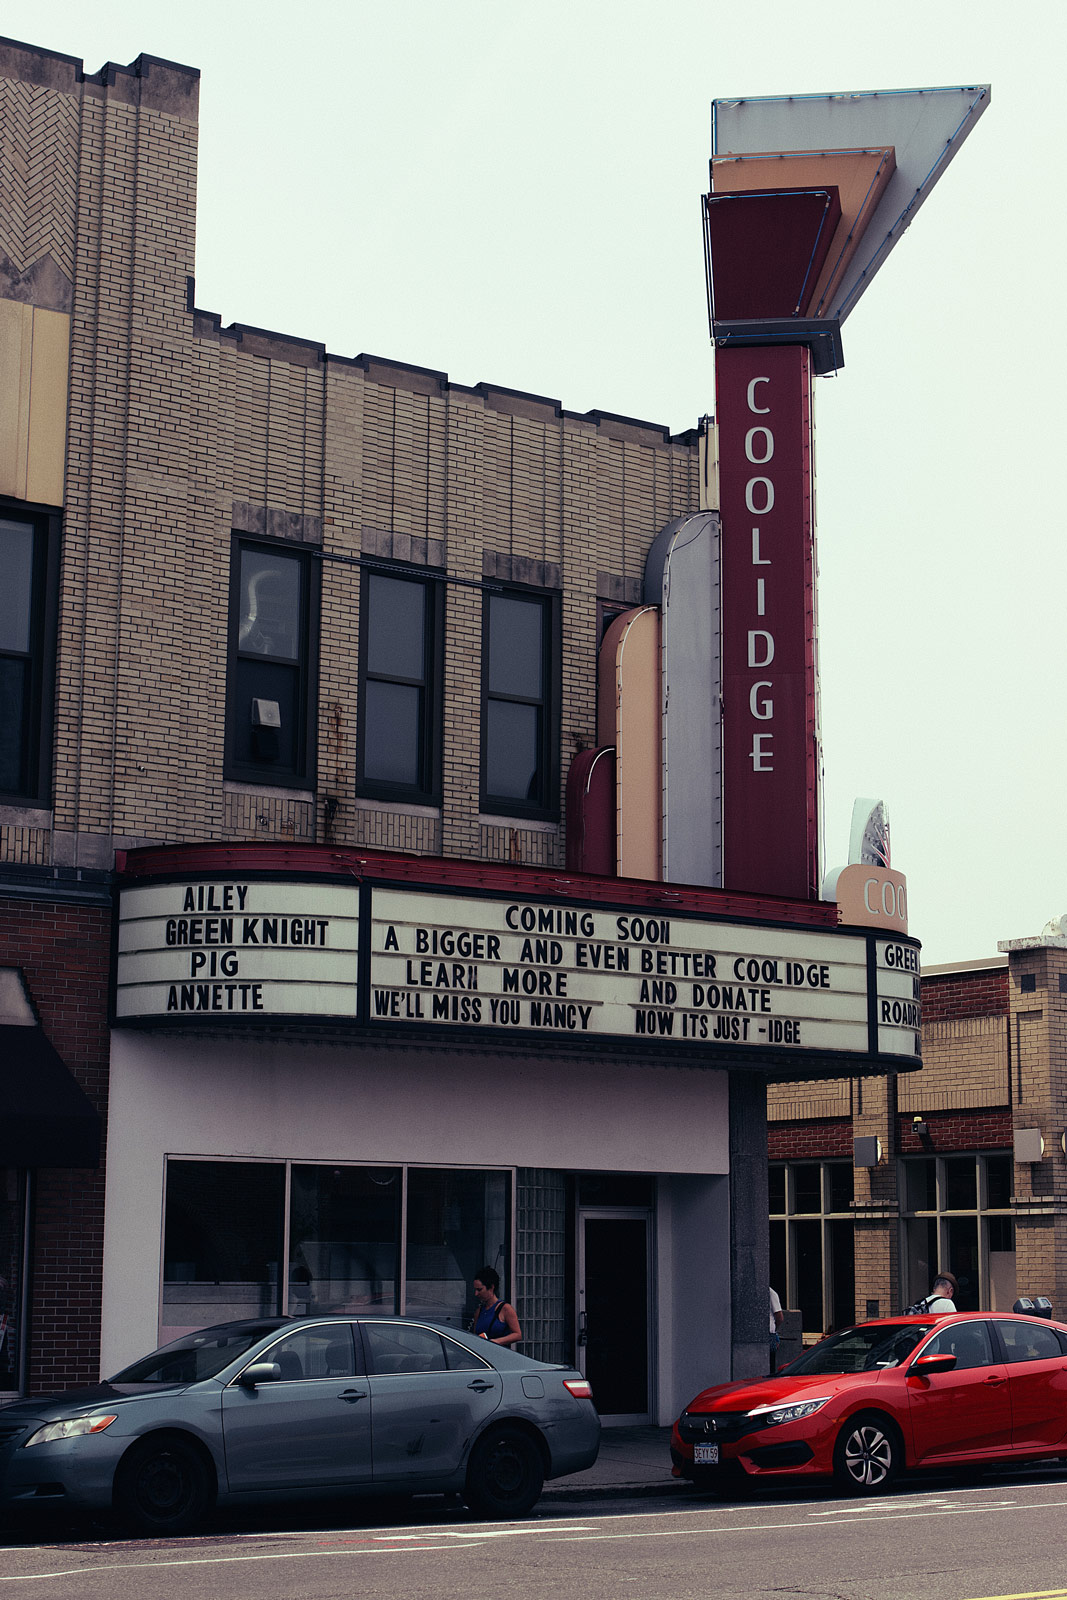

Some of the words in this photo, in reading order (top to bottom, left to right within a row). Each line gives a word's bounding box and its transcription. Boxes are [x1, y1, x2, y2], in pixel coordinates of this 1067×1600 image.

[744, 376, 776, 772] COOLIDGE
[184, 886, 248, 912] AILEY
[864, 878, 907, 920] COO
[166, 919, 233, 945] GREEN
[242, 919, 328, 945] KNIGHT
[506, 905, 594, 937] COMING
[616, 917, 670, 944] SOON
[191, 951, 239, 977] PIG
[384, 926, 399, 951] A
[416, 928, 501, 960] BIGGER
[520, 938, 563, 965] AND
[576, 942, 629, 971] EVEN
[641, 949, 717, 978] BETTER
[734, 957, 830, 988] COOLIDGE
[167, 984, 263, 1011] ANNETTE
[503, 968, 567, 997] MORE
[640, 979, 677, 1005] AND
[693, 984, 771, 1012] DONATE
[375, 990, 424, 1018] WE'LL
[432, 994, 482, 1023] MISS
[490, 999, 520, 1025] YOU
[530, 1001, 592, 1030] NANCY
[635, 1010, 674, 1036] NOW
[683, 1014, 708, 1039] ITS
[713, 1015, 750, 1042] JUST
